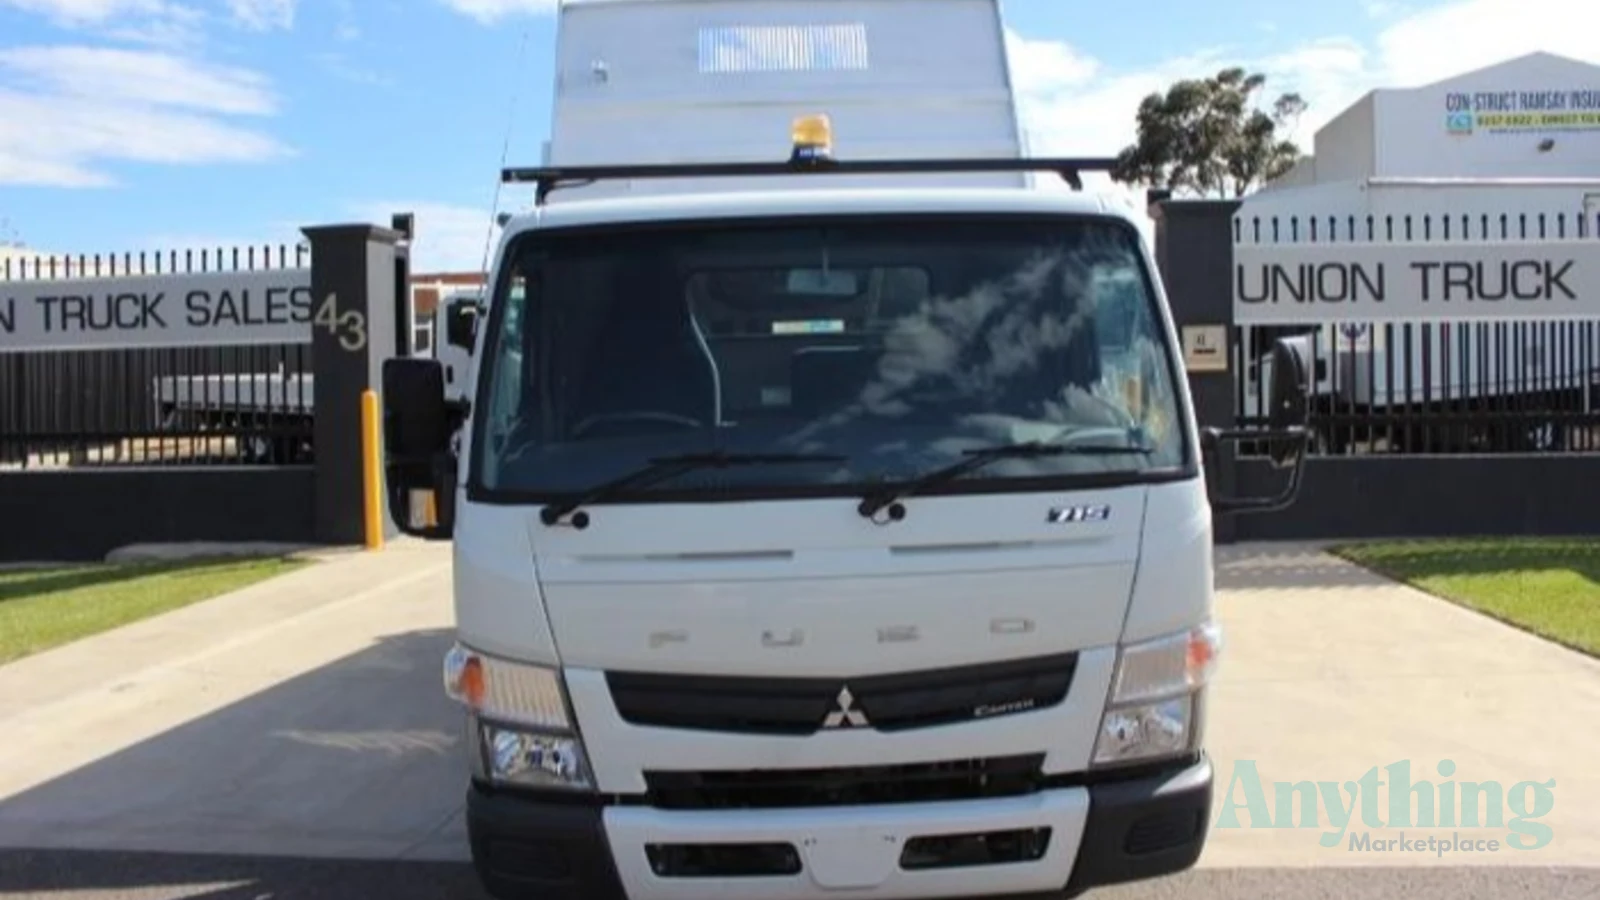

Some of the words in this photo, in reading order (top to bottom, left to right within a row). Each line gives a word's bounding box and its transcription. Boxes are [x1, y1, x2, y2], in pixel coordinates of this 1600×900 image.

[1237, 262, 1385, 303] UNION
[1410, 260, 1577, 301] TRUCK
[35, 292, 168, 332] TRUCK
[185, 287, 313, 327] SALES
[314, 293, 366, 351] 43
